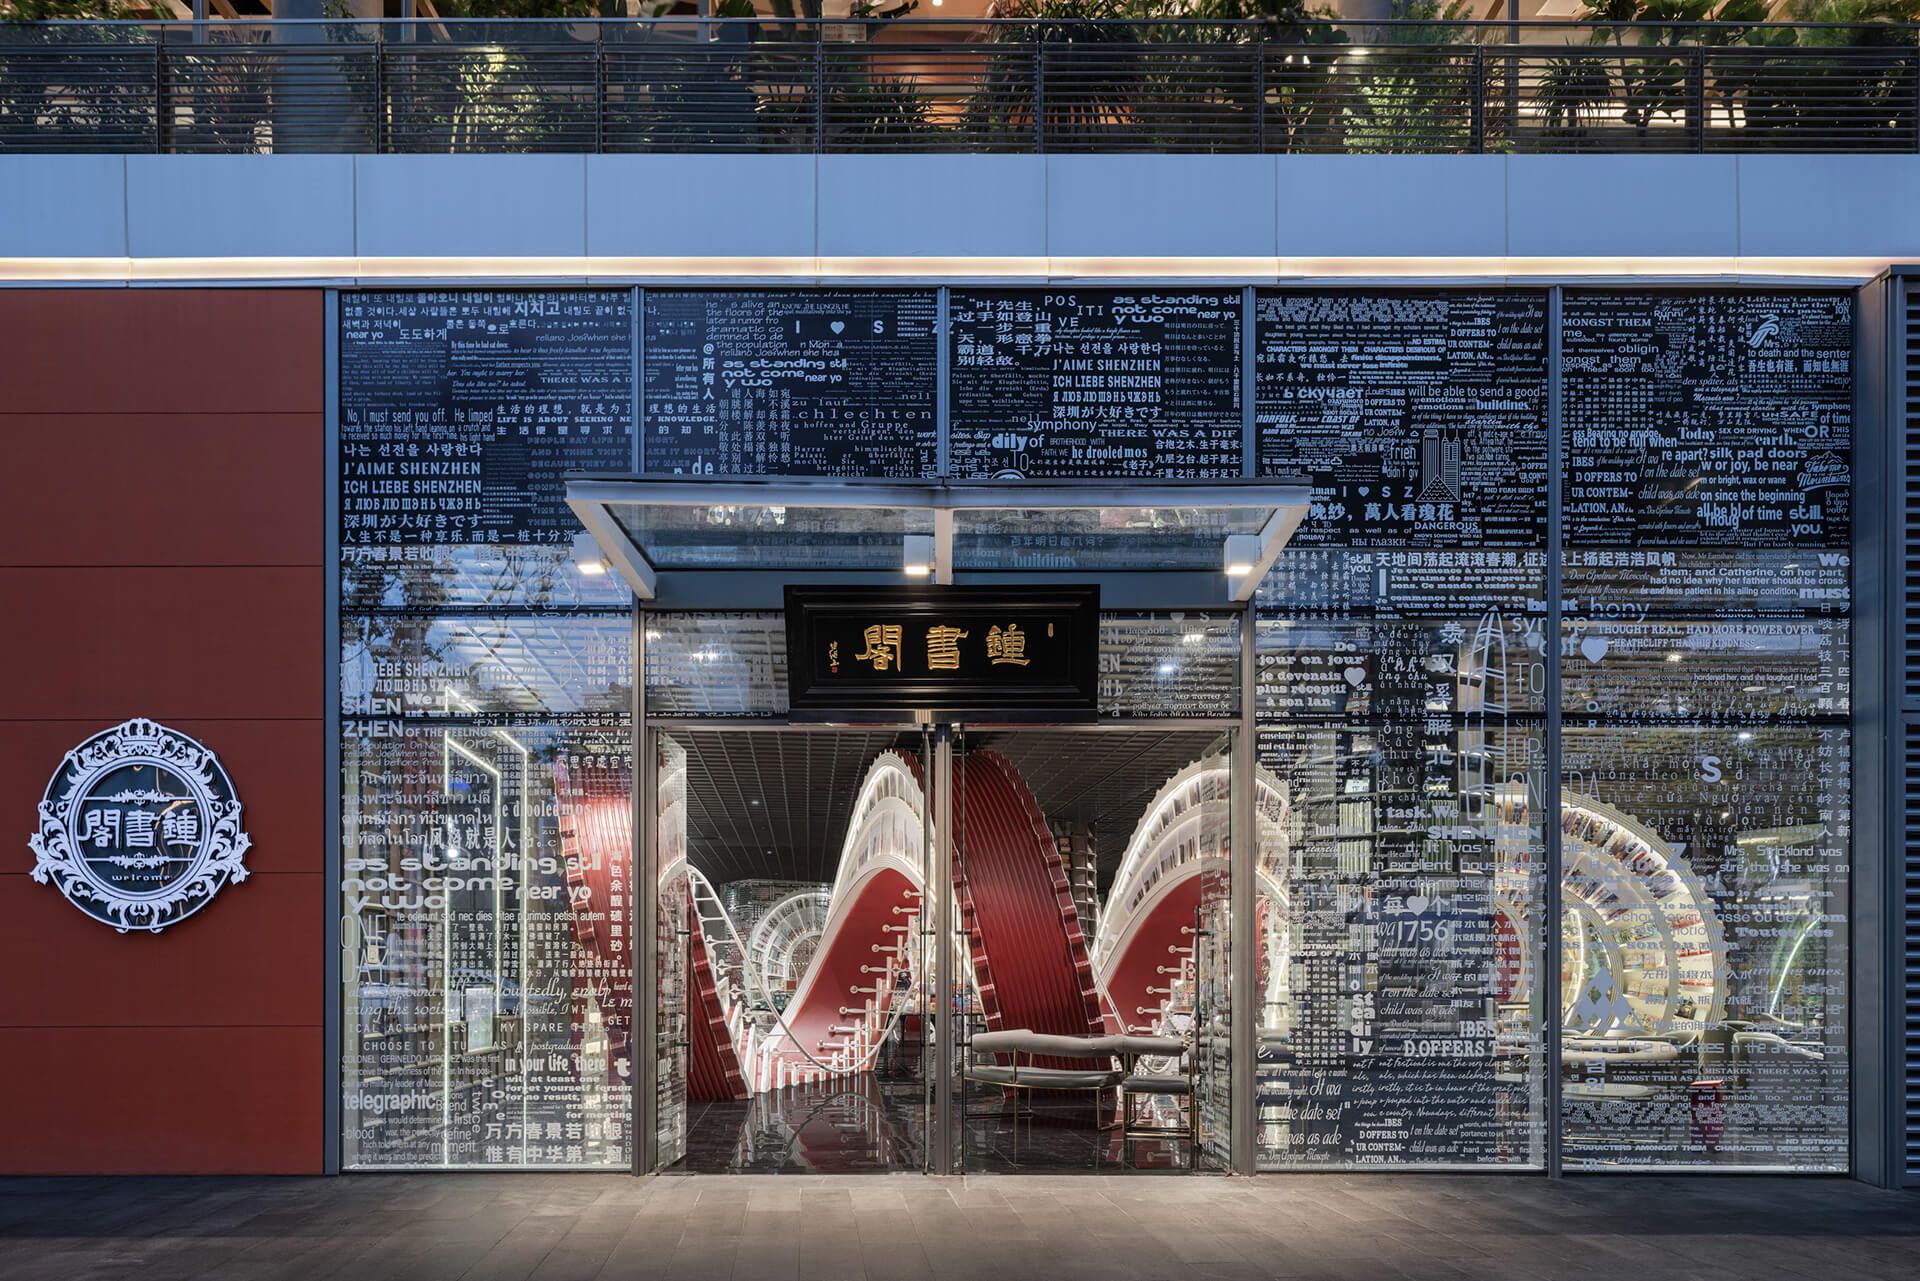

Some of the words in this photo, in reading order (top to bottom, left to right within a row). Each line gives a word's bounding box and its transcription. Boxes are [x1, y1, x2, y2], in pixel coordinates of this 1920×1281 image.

[1044, 295, 1077, 306] POS
[1113, 296, 1135, 304] as
[1141, 294, 1219, 306] standing
[514, 300, 561, 317] 지치고
[1112, 304, 1147, 314] not
[1152, 306, 1197, 314] come
[1197, 311, 1220, 319] near
[1223, 311, 1236, 321] yo
[1059, 316, 1079, 328] VE
[1618, 318, 1652, 327] THEM
[346, 330, 369, 340] near
[400, 328, 447, 341] 도도하게
[706, 325, 765, 333] dramatic
[1487, 328, 1497, 337] TO
[1118, 342, 1163, 355] 사랑한다
[1748, 349, 1755, 358] to
[1758, 348, 1782, 358] death
[1783, 348, 1799, 358] and
[1801, 348, 1815, 358] the
[723, 360, 744, 368] as
[749, 358, 826, 370] standing
[1053, 359, 1093, 371] J'AIME
[1097, 359, 1161, 371] SHENZHEN
[721, 368, 756, 378] not
[760, 369, 805, 378] come
[805, 374, 827, 382] near
[1053, 375, 1072, 388] ICH
[1075, 375, 1104, 388] LIEBE
[1107, 375, 1161, 388] SHENZHEN
[1297, 388, 1364, 400] скучает
[1408, 385, 1426, 396] will
[1429, 385, 1441, 396] be
[1443, 385, 1465, 396] able
[1467, 386, 1478, 396] to
[1480, 385, 1504, 396] send
[1515, 385, 1540, 400] good
[370, 408, 389, 423] must
[393, 408, 412, 423] send
[415, 411, 429, 426] you
[455, 408, 465, 422] He
[469, 408, 494, 426] limped
[1053, 405, 1162, 419] 深圳が大好きです
[861, 420, 909, 432] Gruppe
[1027, 418, 1097, 433] symphony
[1804, 425, 1829, 438] OR
[1098, 429, 1148, 438] THERE
[1152, 429, 1190, 438] WAS
[1195, 429, 1206, 438] A
[1677, 427, 1716, 441] Today
[992, 432, 1028, 452] dily
[1029, 434, 1046, 448] of
[1649, 436, 1678, 448] when
[344, 443, 371, 457] 나는
[379, 443, 420, 457] 선전을
[426, 443, 483, 457] 사랑한다
[1072, 446, 1083, 459] he
[1086, 445, 1123, 459] drooled
[1124, 448, 1148, 458] mos
[1675, 448, 1708, 463] apart?
[1709, 447, 1733, 458] silk
[1738, 447, 1764, 461] pad
[1768, 447, 1808, 458] doors
[344, 462, 395, 475] J'AIME
[400, 462, 481, 475] SHENZHEN
[1715, 461, 1728, 470] or
[1730, 459, 1751, 473] joy,
[1754, 459, 1769, 471] be
[1772, 461, 1799, 471] near
[344, 480, 368, 494] ICH
[372, 480, 409, 494] LIEBE
[413, 480, 482, 494] SHENZHEN
[1715, 489, 1739, 501] since
[1741, 489, 1757, 501] the
[1758, 489, 1806, 504] beginning
[1742, 505, 1755, 520] of
[1757, 505, 1783, 520] time
[1789, 504, 1825, 520] still.
[344, 513, 483, 528] 深圳が大好きです
[1414, 522, 1479, 530] DANGEROUS
[1791, 523, 1824, 537] you.
[1818, 552, 1850, 567] We
[1350, 565, 1373, 575] you.
[1695, 568, 1716, 577] and
[1718, 567, 1777, 578] Catherine,
[1780, 569, 1794, 577] on
[1797, 568, 1816, 577] her
[1819, 569, 1845, 579] part,
[1650, 576, 1667, 585] had
[1705, 577, 1722, 586] why
[1743, 576, 1770, 585] father
[1772, 576, 1801, 585] should
[1723, 586, 1736, 595] his
[1760, 586, 1799, 597] condition,
[1800, 587, 1850, 599] must
[1597, 624, 1648, 634] THOUGHT
[1651, 624, 1685, 635] REAL,
[1686, 624, 1709, 634] HAD
[1712, 624, 1743, 634] MORE
[1745, 624, 1783, 634] POWER
[1786, 624, 1816, 634] OVER
[1259, 655, 1296, 666] jour
[1260, 671, 1274, 682] je
[1277, 671, 1342, 682] devenais
[342, 698, 401, 715] SHEN
[1279, 697, 1305, 707] son
[342, 720, 404, 738] ZHEN
[1386, 805, 1431, 818] task.
[1432, 805, 1460, 818] We
[1757, 845, 1814, 857] Strickland
[1819, 848, 1843, 857] was
[401, 852, 557, 875] standing
[112, 874, 171, 882] welcome
[342, 872, 411, 892] not
[423, 877, 514, 892] come
[568, 887, 592, 904] yo
[1398, 920, 1449, 943] 1756
[1419, 1039, 1486, 1057] OFFERS
[342, 1089, 437, 1115] telegraphic
[1366, 1130, 1397, 1138] OFFERS
[1398, 1130, 1408, 1138] TO
